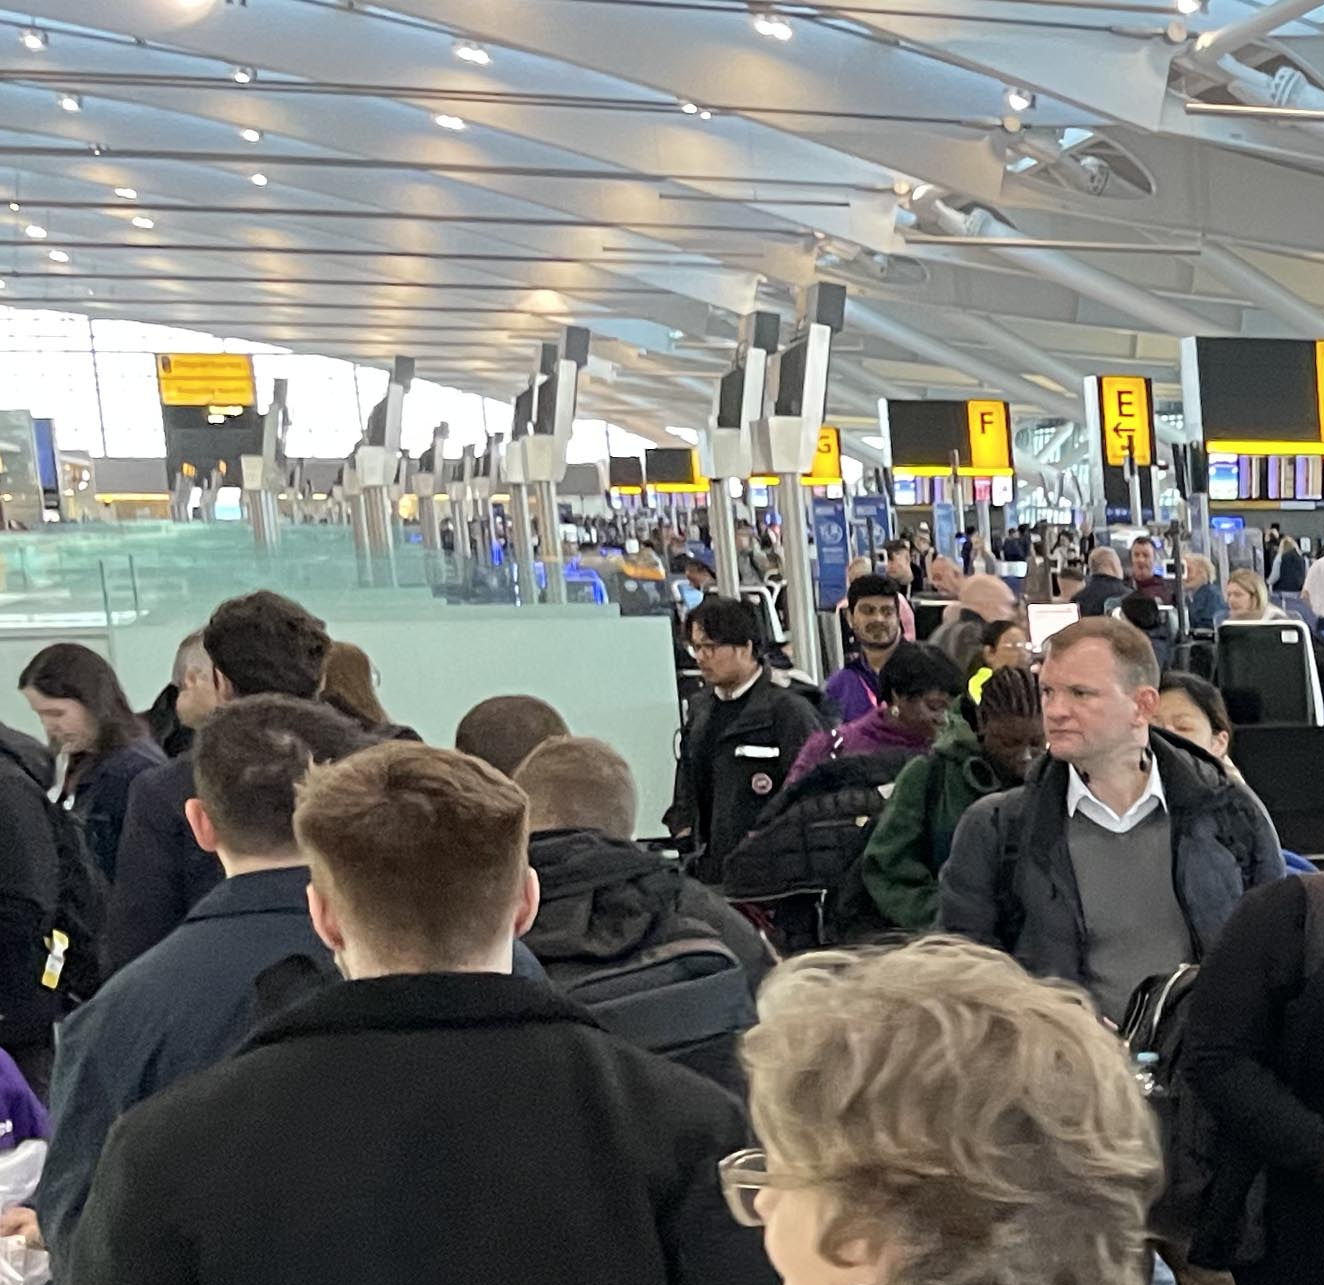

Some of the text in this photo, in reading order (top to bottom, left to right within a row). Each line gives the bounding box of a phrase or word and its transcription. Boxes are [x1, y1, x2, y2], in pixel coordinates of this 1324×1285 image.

[1116, 390, 1135, 417] E
[979, 411, 995, 435] F
[817, 435, 831, 454] G
